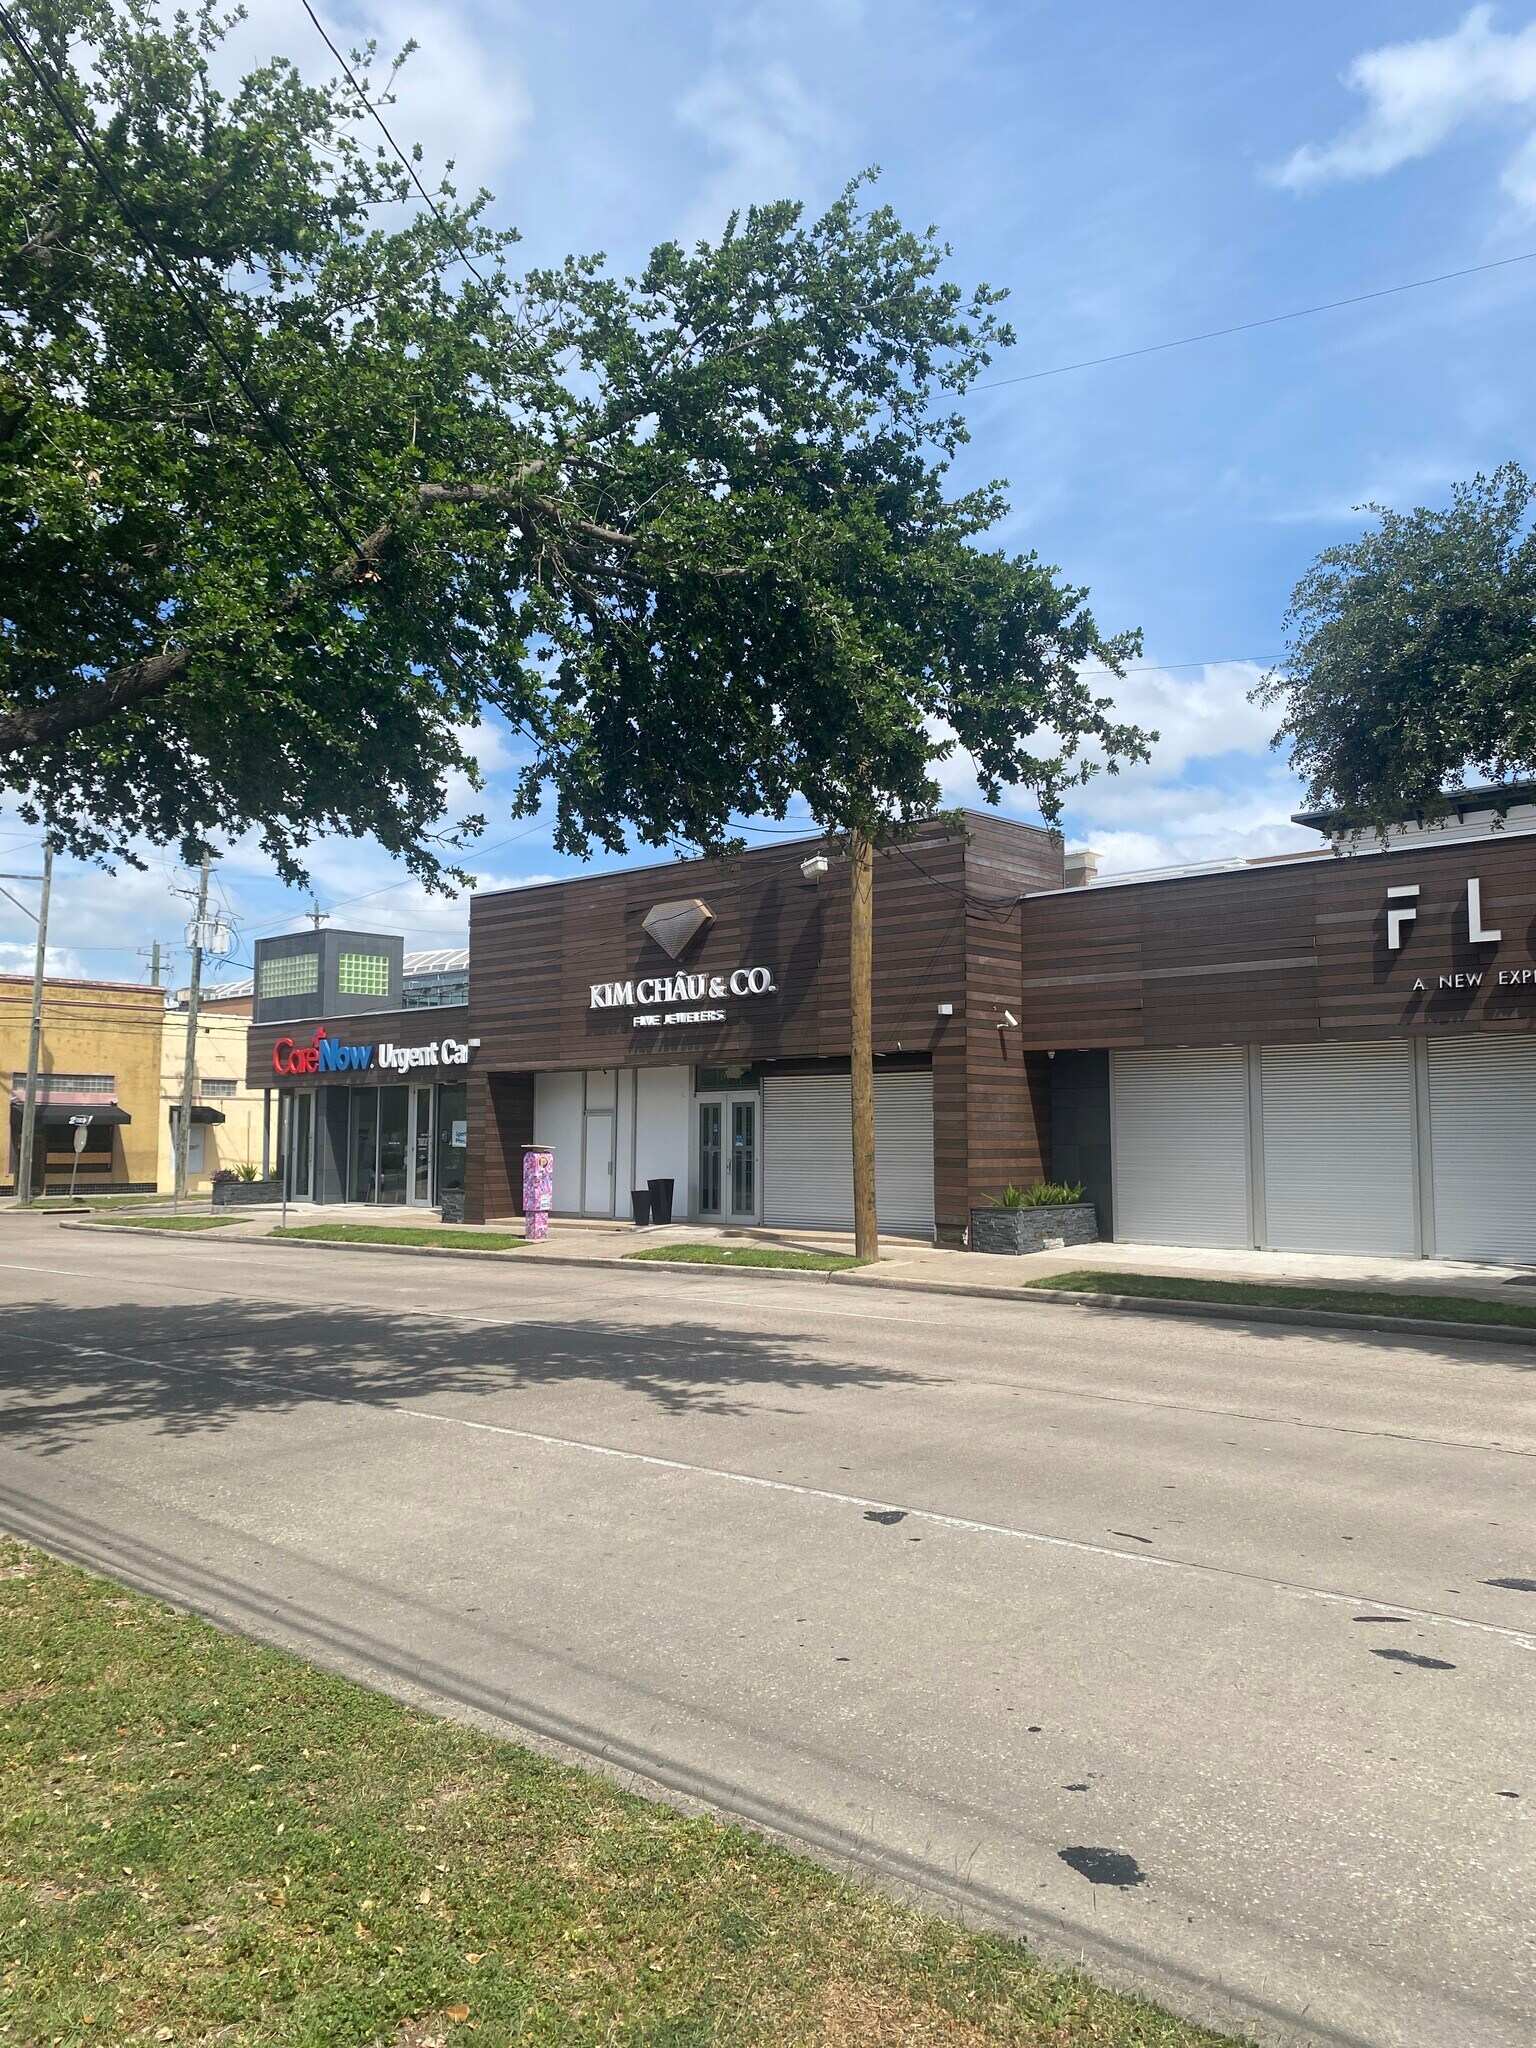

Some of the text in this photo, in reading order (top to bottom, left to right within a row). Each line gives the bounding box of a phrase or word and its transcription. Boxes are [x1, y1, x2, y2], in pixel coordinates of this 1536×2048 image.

[590, 981, 635, 1009] KIM
[636, 971, 708, 1004] CHÂU
[708, 976, 730, 999] &
[1413, 969, 1536, 991] A NEW EXP
[633, 1015, 661, 1027] FINE
[379, 1042, 439, 1074] Urgent
